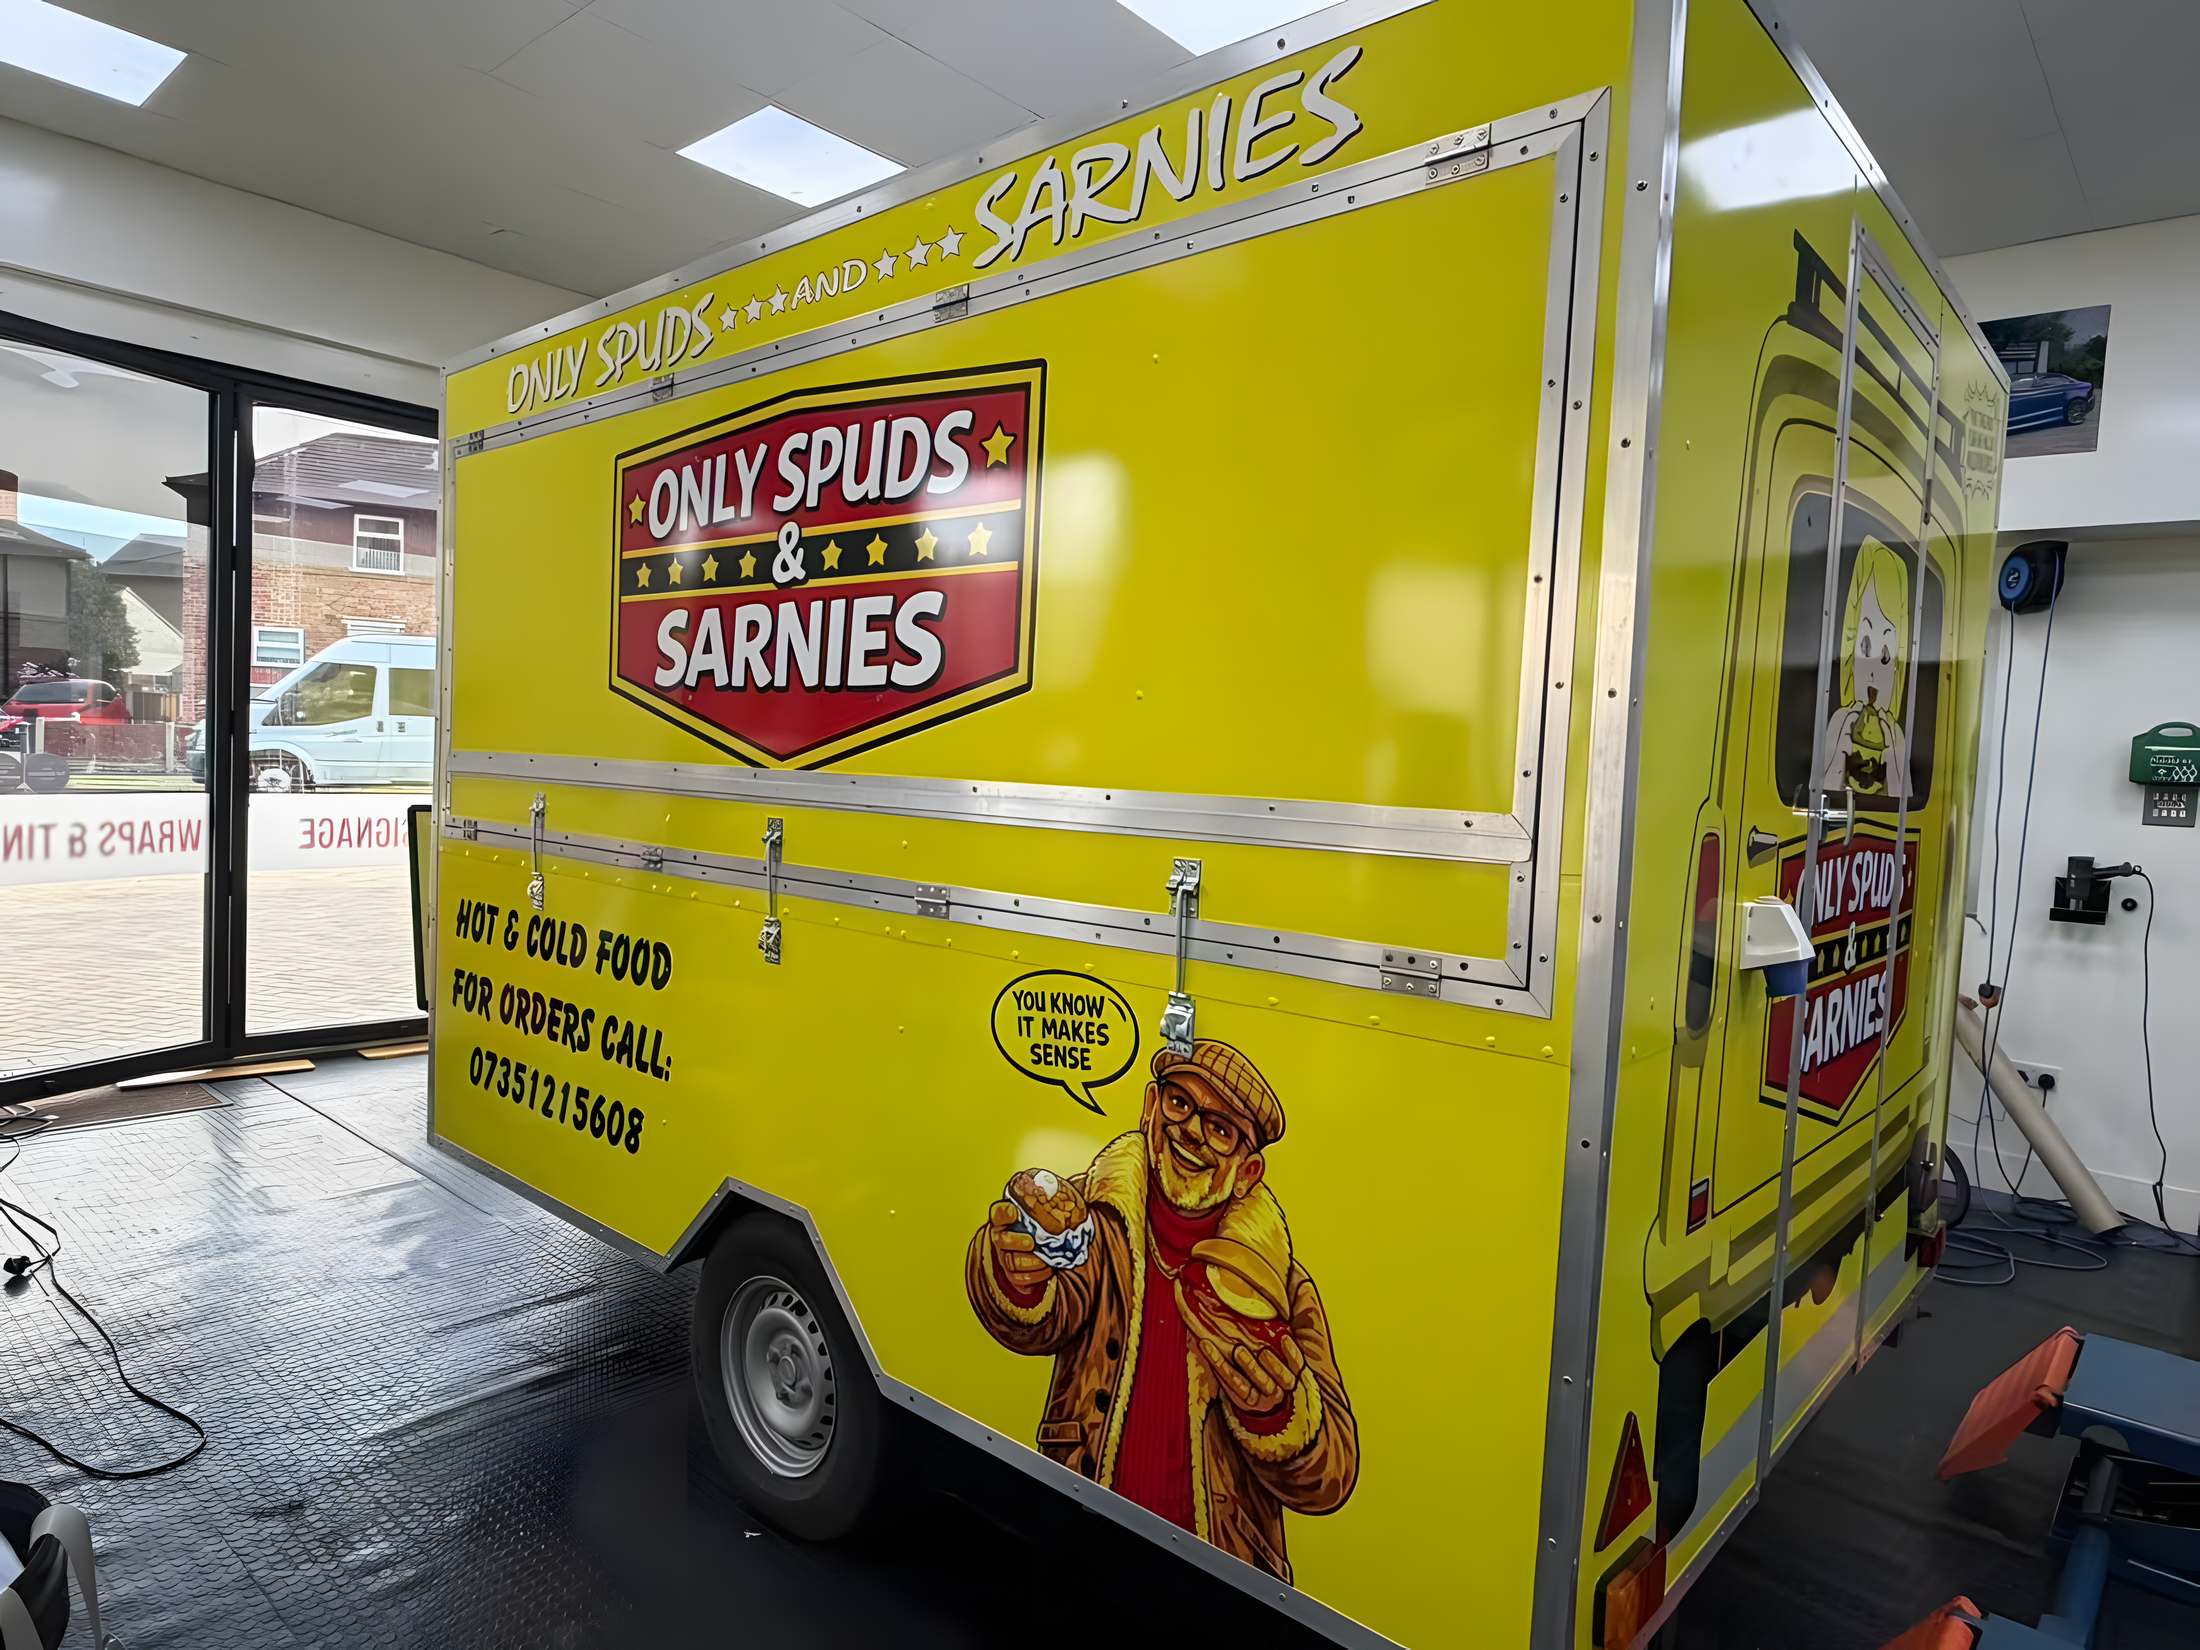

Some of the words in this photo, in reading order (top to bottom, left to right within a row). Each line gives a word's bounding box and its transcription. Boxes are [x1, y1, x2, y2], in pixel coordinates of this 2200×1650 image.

[506, 337, 588, 414] ONLY
[595, 291, 715, 387] SPUDS
[791, 258, 868, 310] AND
[973, 45, 1363, 269] SARNIES
[647, 442, 769, 540] ONLY
[772, 409, 974, 514] SPUDS
[771, 520, 808, 585] &
[653, 589, 946, 690] SARNIES
[456, 898, 499, 945] HOT
[503, 909, 520, 951] &
[526, 915, 588, 968] COLD
[595, 929, 672, 991] FOOD
[1844, 920, 1857, 972] &
[452, 967, 493, 1022] FOR
[499, 982, 595, 1053] ORDERS
[601, 1015, 672, 1082] CALL:
[1012, 989, 1046, 1012] YOU
[1050, 991, 1105, 1019] KNOW
[1017, 1016, 1035, 1038] IT
[1041, 1017, 1110, 1047] MAKES
[469, 1046, 645, 1155] 07351215608
[1030, 1043, 1092, 1071] SENSE
